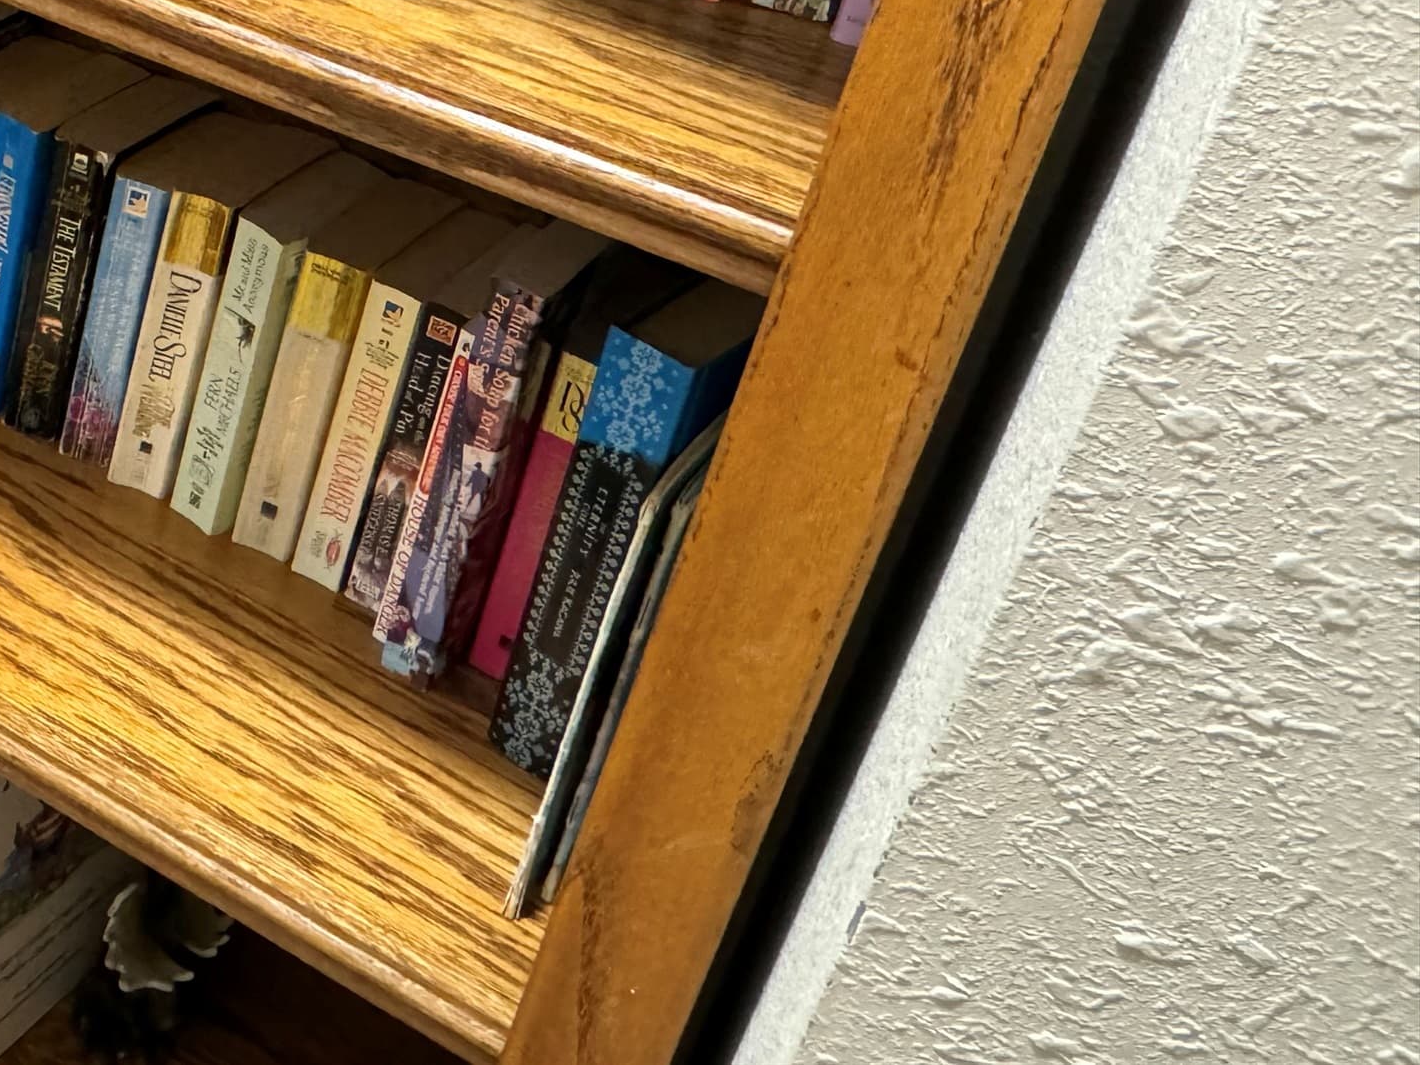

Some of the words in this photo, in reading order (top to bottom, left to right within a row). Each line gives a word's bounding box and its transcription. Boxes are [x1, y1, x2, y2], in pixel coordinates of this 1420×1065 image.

[56, 217, 82, 242] THE
[42, 243, 79, 311] TESTAMENT
[162, 270, 204, 337] DANIELLE
[479, 294, 511, 359] Parent's
[498, 302, 534, 365] Chicken
[147, 334, 188, 383] STEEL
[408, 352, 432, 393] Head
[417, 354, 452, 418] Dancing
[204, 373, 224, 412] FERN
[348, 367, 389, 433] DEBBIE
[484, 367, 512, 409] Soup
[395, 410, 416, 434] Pin
[478, 409, 501, 434] for
[320, 433, 370, 524] MACOMBER
[401, 495, 430, 547] HOUSE
[579, 486, 609, 558] ETERNITY
[394, 550, 410, 574] OF
[377, 576, 404, 635] DANGER
